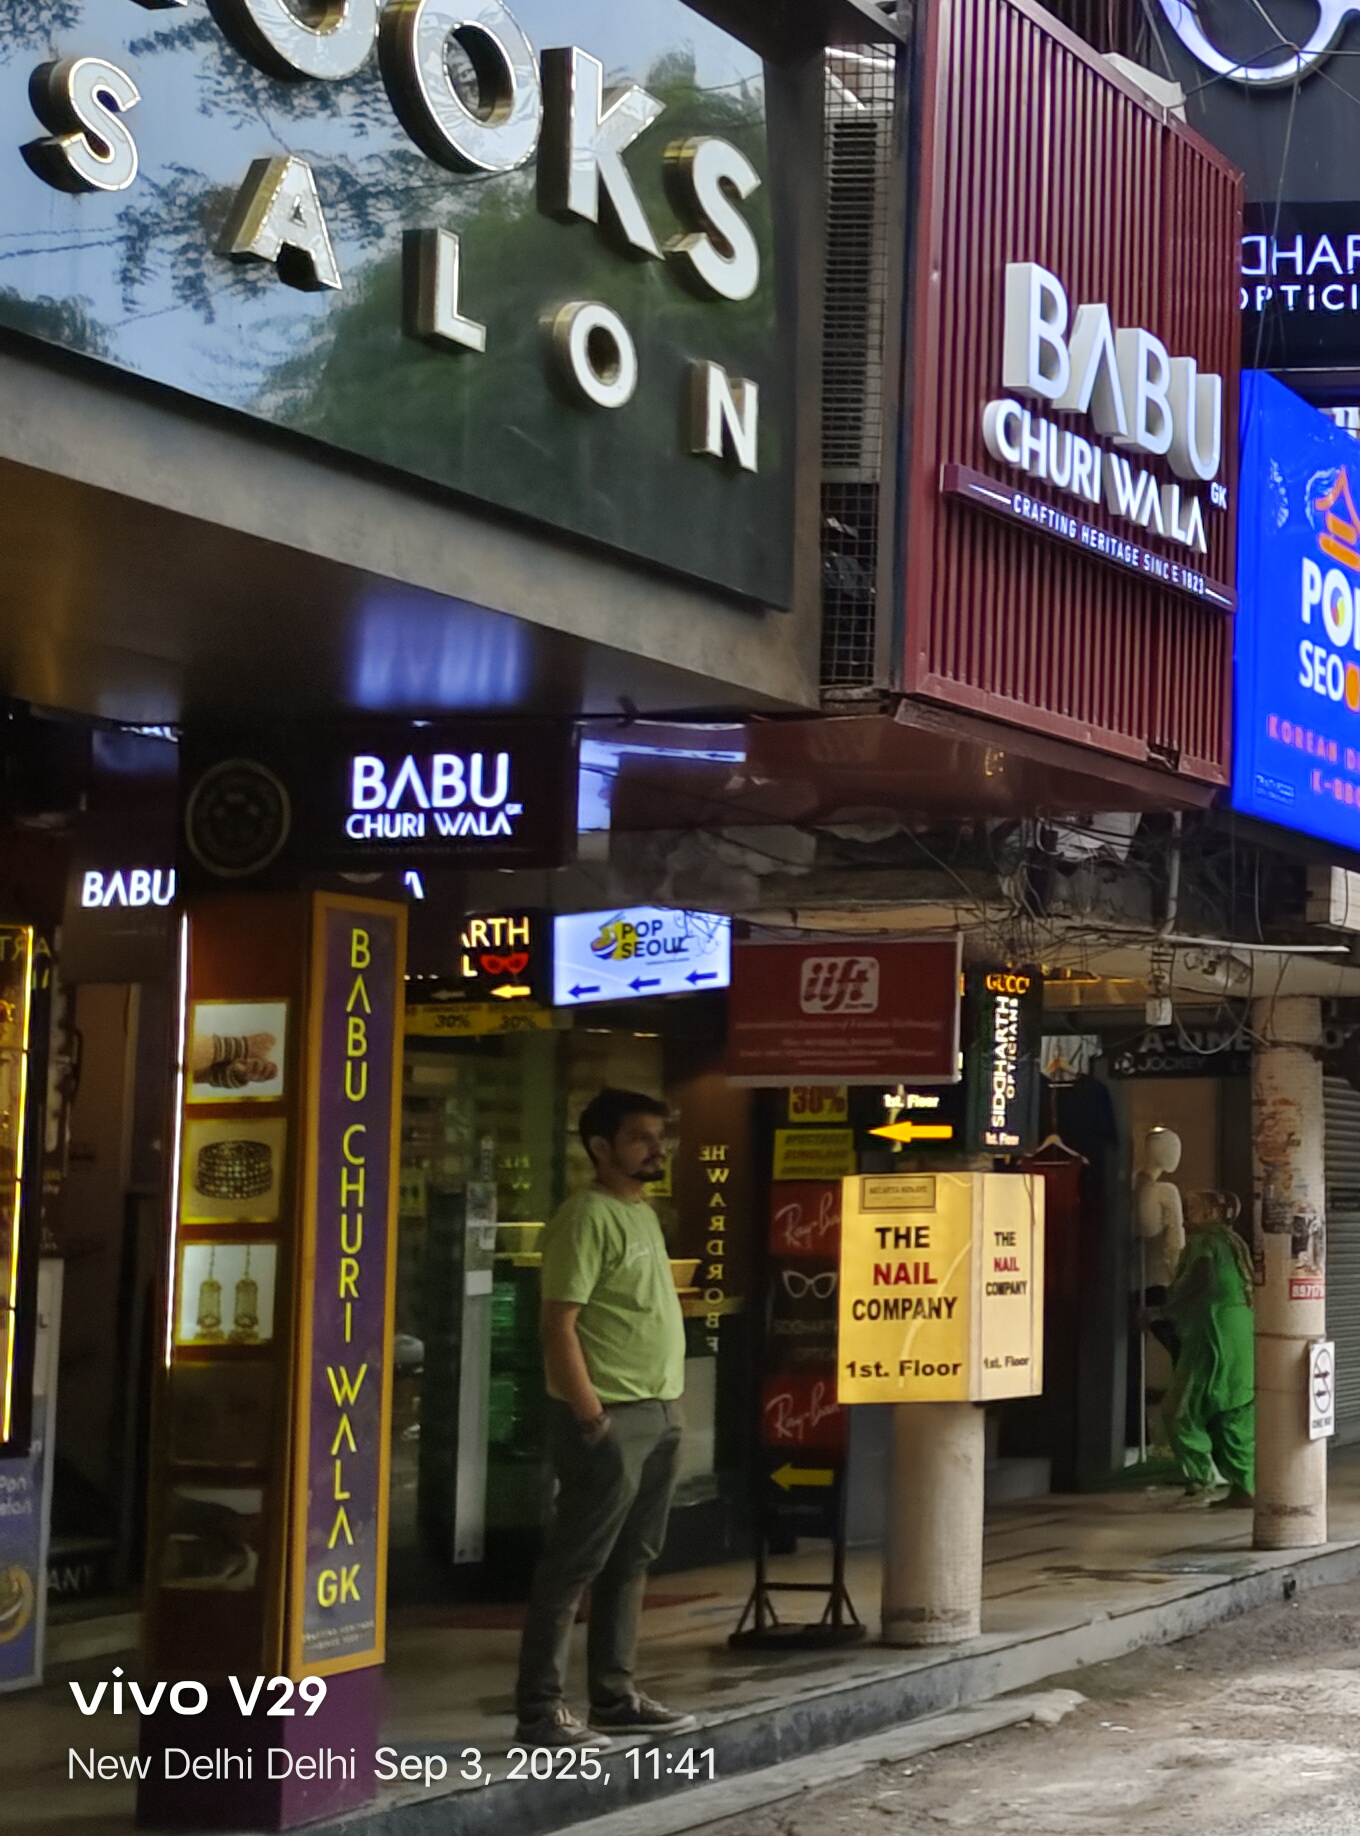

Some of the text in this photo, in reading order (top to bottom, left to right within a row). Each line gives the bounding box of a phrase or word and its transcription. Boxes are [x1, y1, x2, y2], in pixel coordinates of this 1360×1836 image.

[130, 0, 763, 301] OKS
[19, 57, 760, 473] SALON
[1004, 262, 1221, 480] BABU
[982, 399, 1228, 554] CHURI WALA GK
[1013, 494, 1076, 539] CRAFTING
[1081, 525, 1139, 566] HERITAGE
[1144, 554, 1179, 582] SINCE
[1267, 714, 1338, 764] KOREAN
[351, 752, 509, 811] BABU
[346, 812, 425, 839] CHURI
[434, 811, 512, 837] WALA
[82, 869, 175, 907] BABU
[622, 920, 663, 940] POP
[622, 937, 688, 958] SEOUL
[344, 928, 373, 1102] BABU
[338, 1124, 367, 1343] CHURI
[775, 1192, 841, 1249] Ray-Ba
[875, 1226, 930, 1250] THE
[994, 1231, 1016, 1247] THE
[873, 1262, 938, 1286] NAIL
[994, 1257, 1020, 1272] NAIL
[852, 1297, 958, 1321] COMPANY
[985, 1280, 1027, 1297] COMPANY
[845, 1361, 962, 1378] 1st. Floor
[1004, 1354, 1030, 1369] Floor
[326, 1363, 368, 1550] WALA
[317, 1564, 361, 1608] GK
